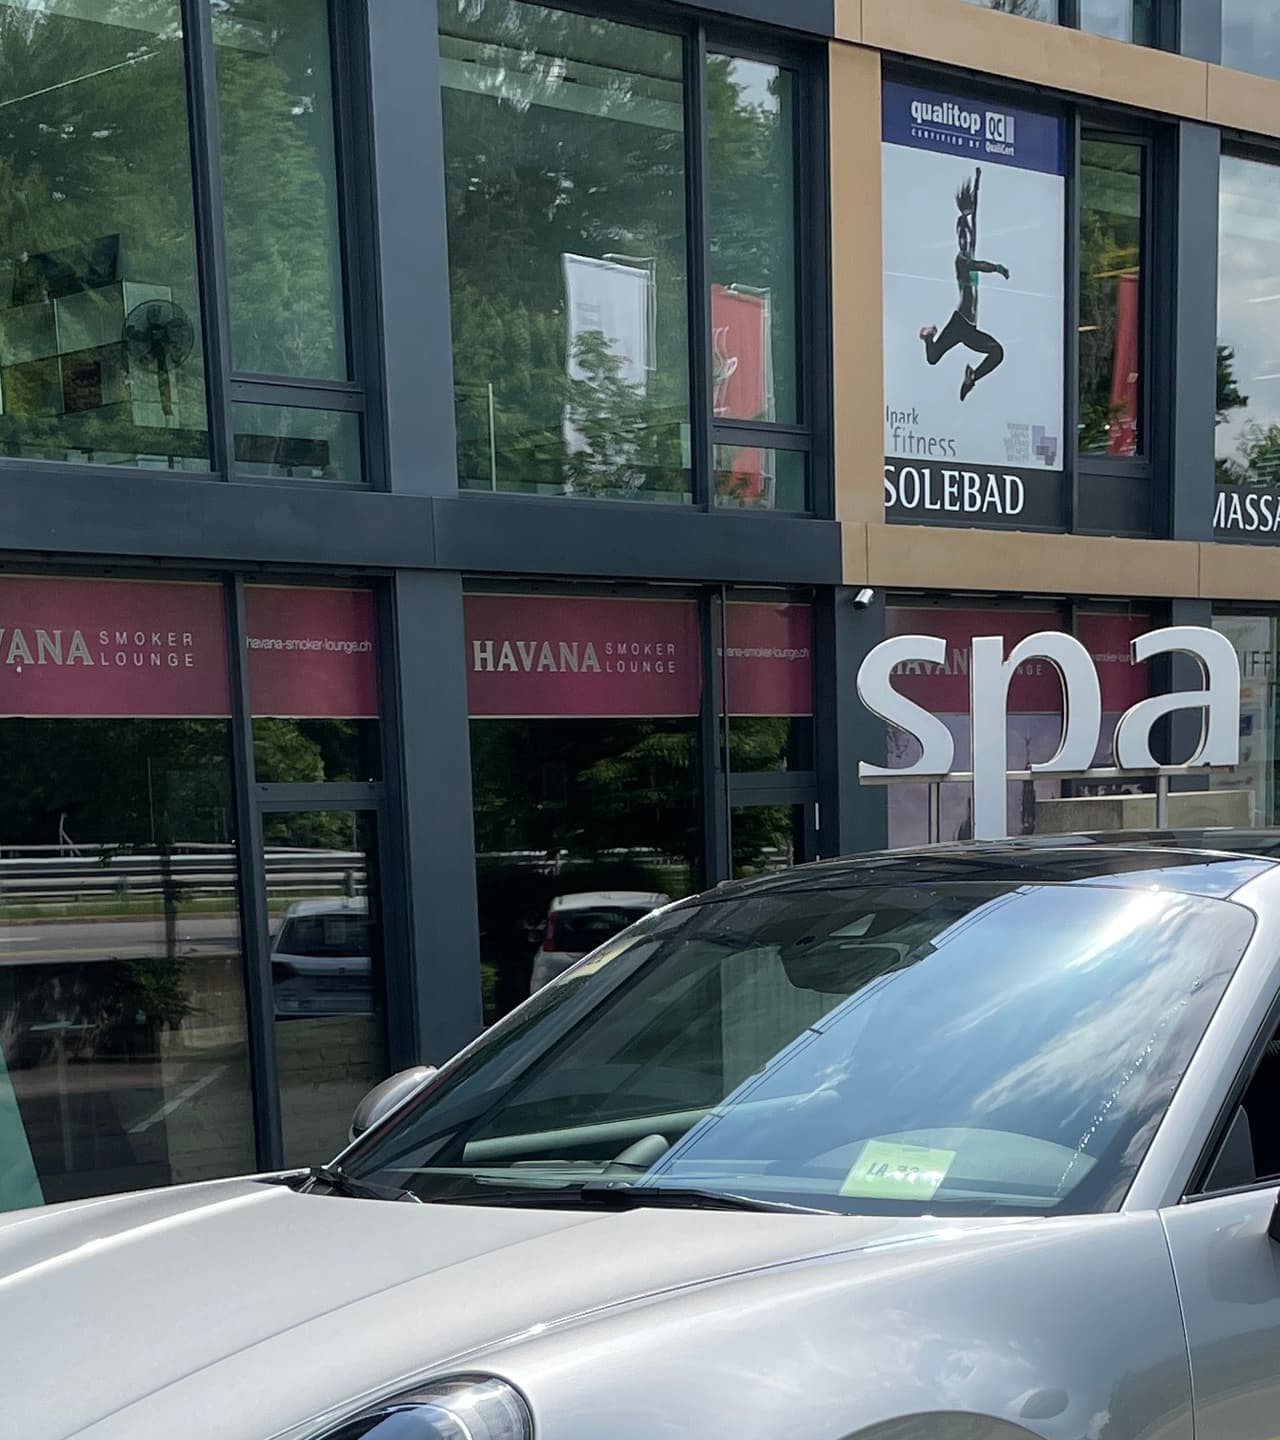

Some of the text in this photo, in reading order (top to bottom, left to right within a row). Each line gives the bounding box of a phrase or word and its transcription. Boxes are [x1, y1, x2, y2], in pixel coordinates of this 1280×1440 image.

[911, 100, 981, 134] qualitop
[893, 426, 957, 457] fitness
[884, 464, 1025, 515] SOLEBAD
[99, 630, 194, 647] SMOKER
[100, 651, 195, 668] LOUNGE
[472, 640, 676, 674] HAVANA SMOKER
[605, 659, 677, 674] LOUNGE
[856, 626, 1240, 841] spa
